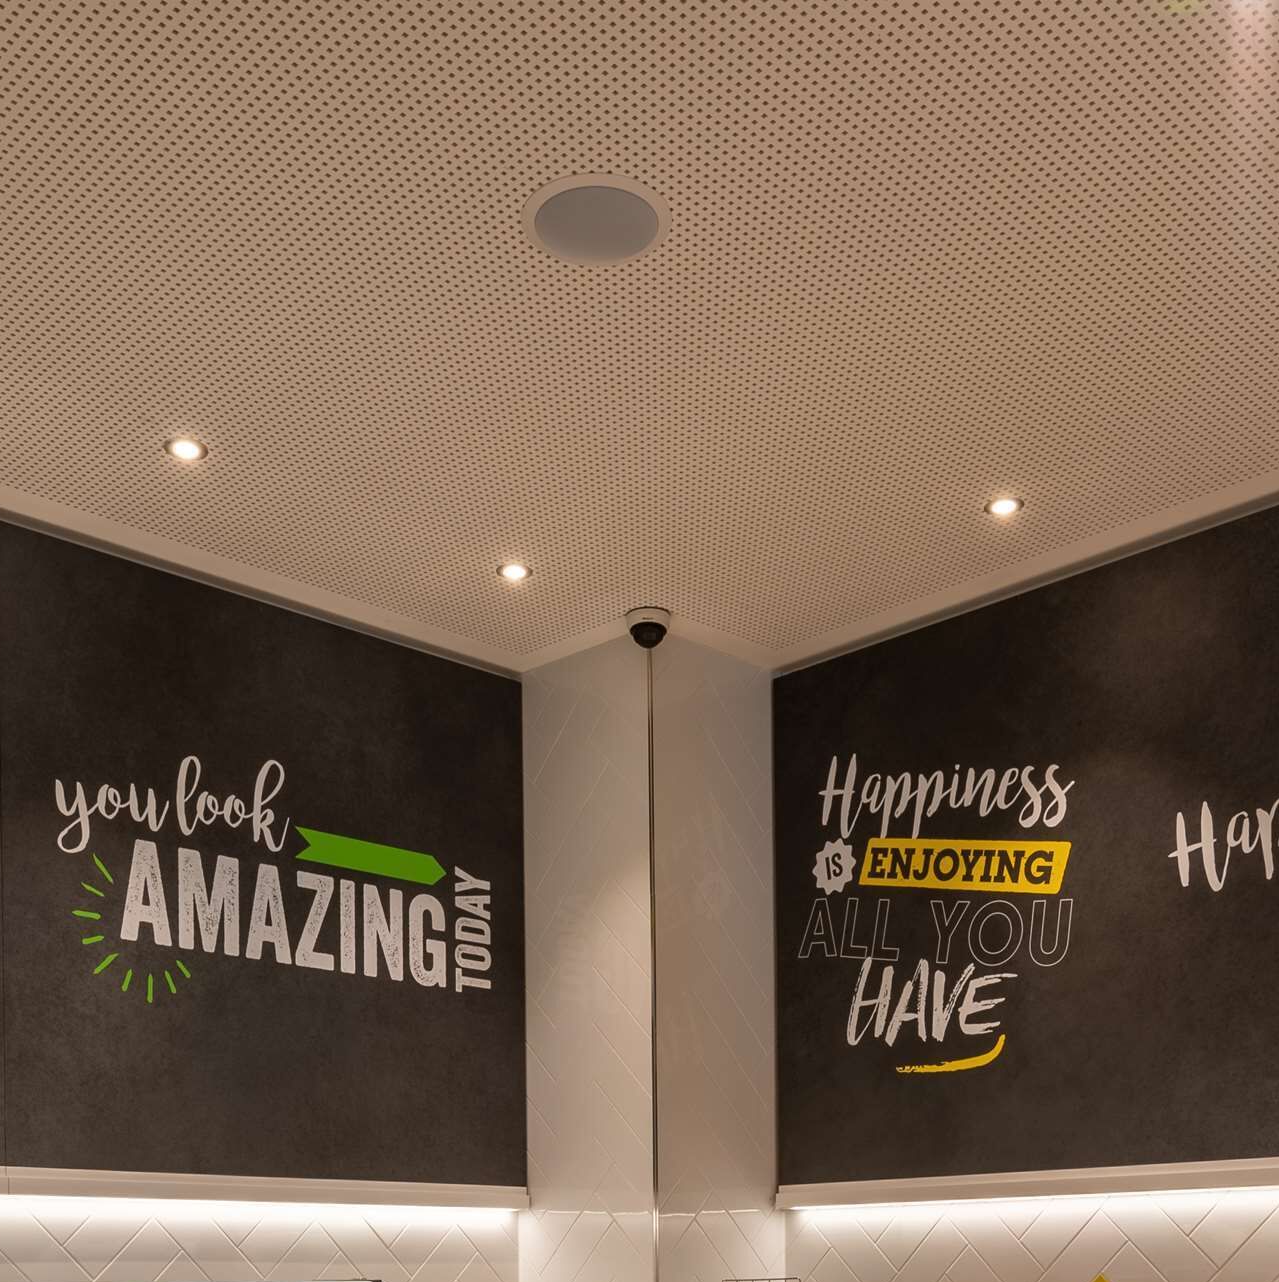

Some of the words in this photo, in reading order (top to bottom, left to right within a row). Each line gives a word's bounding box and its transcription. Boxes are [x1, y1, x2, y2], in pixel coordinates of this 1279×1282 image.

[55, 779, 169, 853] you
[176, 755, 290, 852] look
[818, 753, 1075, 840] Happiness
[825, 853, 843, 880] IS
[867, 847, 1054, 885] ENJOYING
[120, 838, 447, 989] AMAZING
[455, 866, 492, 993] TODAY
[798, 898, 901, 961] ALL
[930, 898, 1073, 967] YOU
[847, 957, 1018, 1047] HAVE
